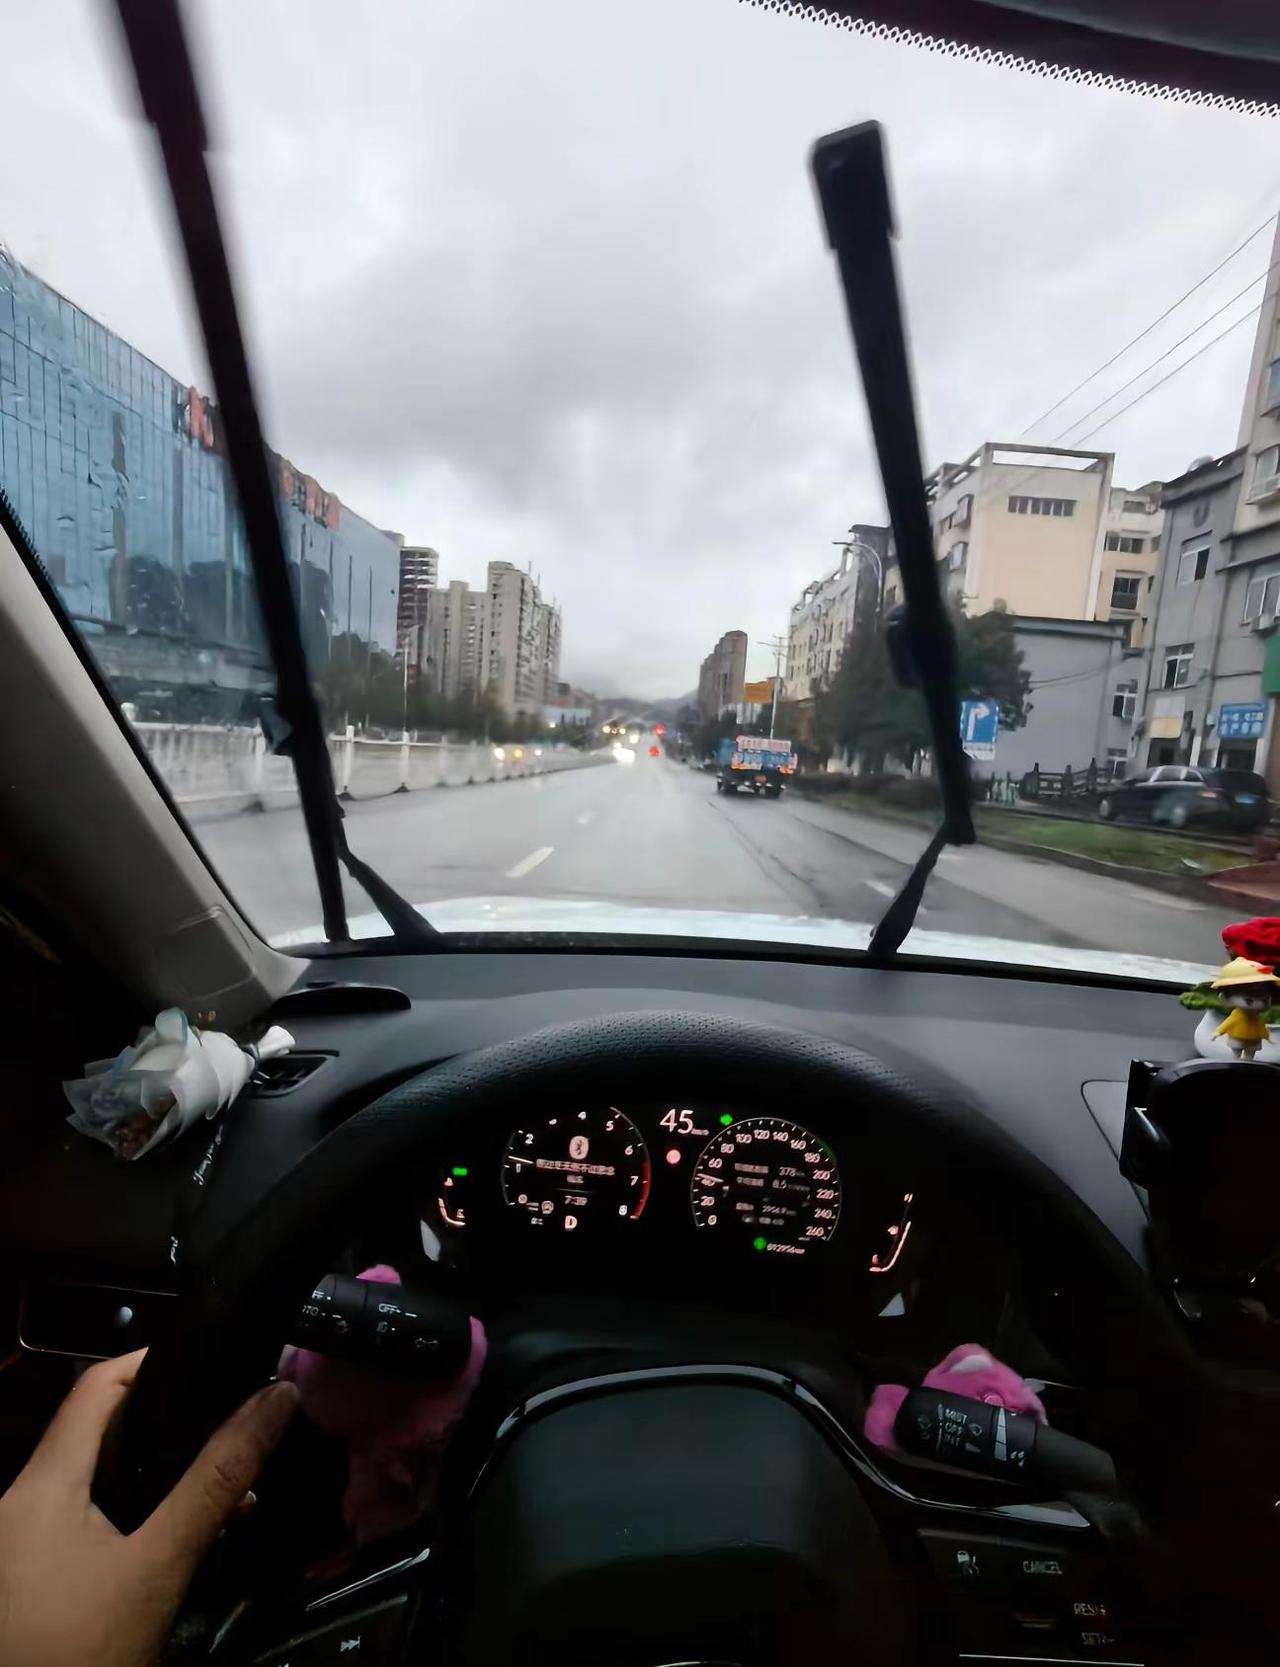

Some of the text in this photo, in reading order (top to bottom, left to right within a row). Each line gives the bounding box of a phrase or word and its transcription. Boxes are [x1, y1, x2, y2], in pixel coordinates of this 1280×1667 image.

[606, 1121, 613, 1131] 5
[660, 1109, 694, 1134] 45
[525, 1133, 533, 1144] 2
[736, 1134, 752, 1143] 100
[754, 1129, 770, 1139] 120
[773, 1132, 788, 1141] 140
[721, 1143, 734, 1153] 80
[790, 1139, 806, 1150] 160
[625, 1145, 633, 1155] 6
[804, 1151, 820, 1163] 180
[708, 1158, 723, 1169] 60
[813, 1170, 831, 1180] 200
[631, 1176, 638, 1186] 7
[816, 1189, 833, 1199] 220
[701, 1196, 714, 1206] 20
[565, 1216, 577, 1230] D
[806, 1226, 824, 1237] 260
